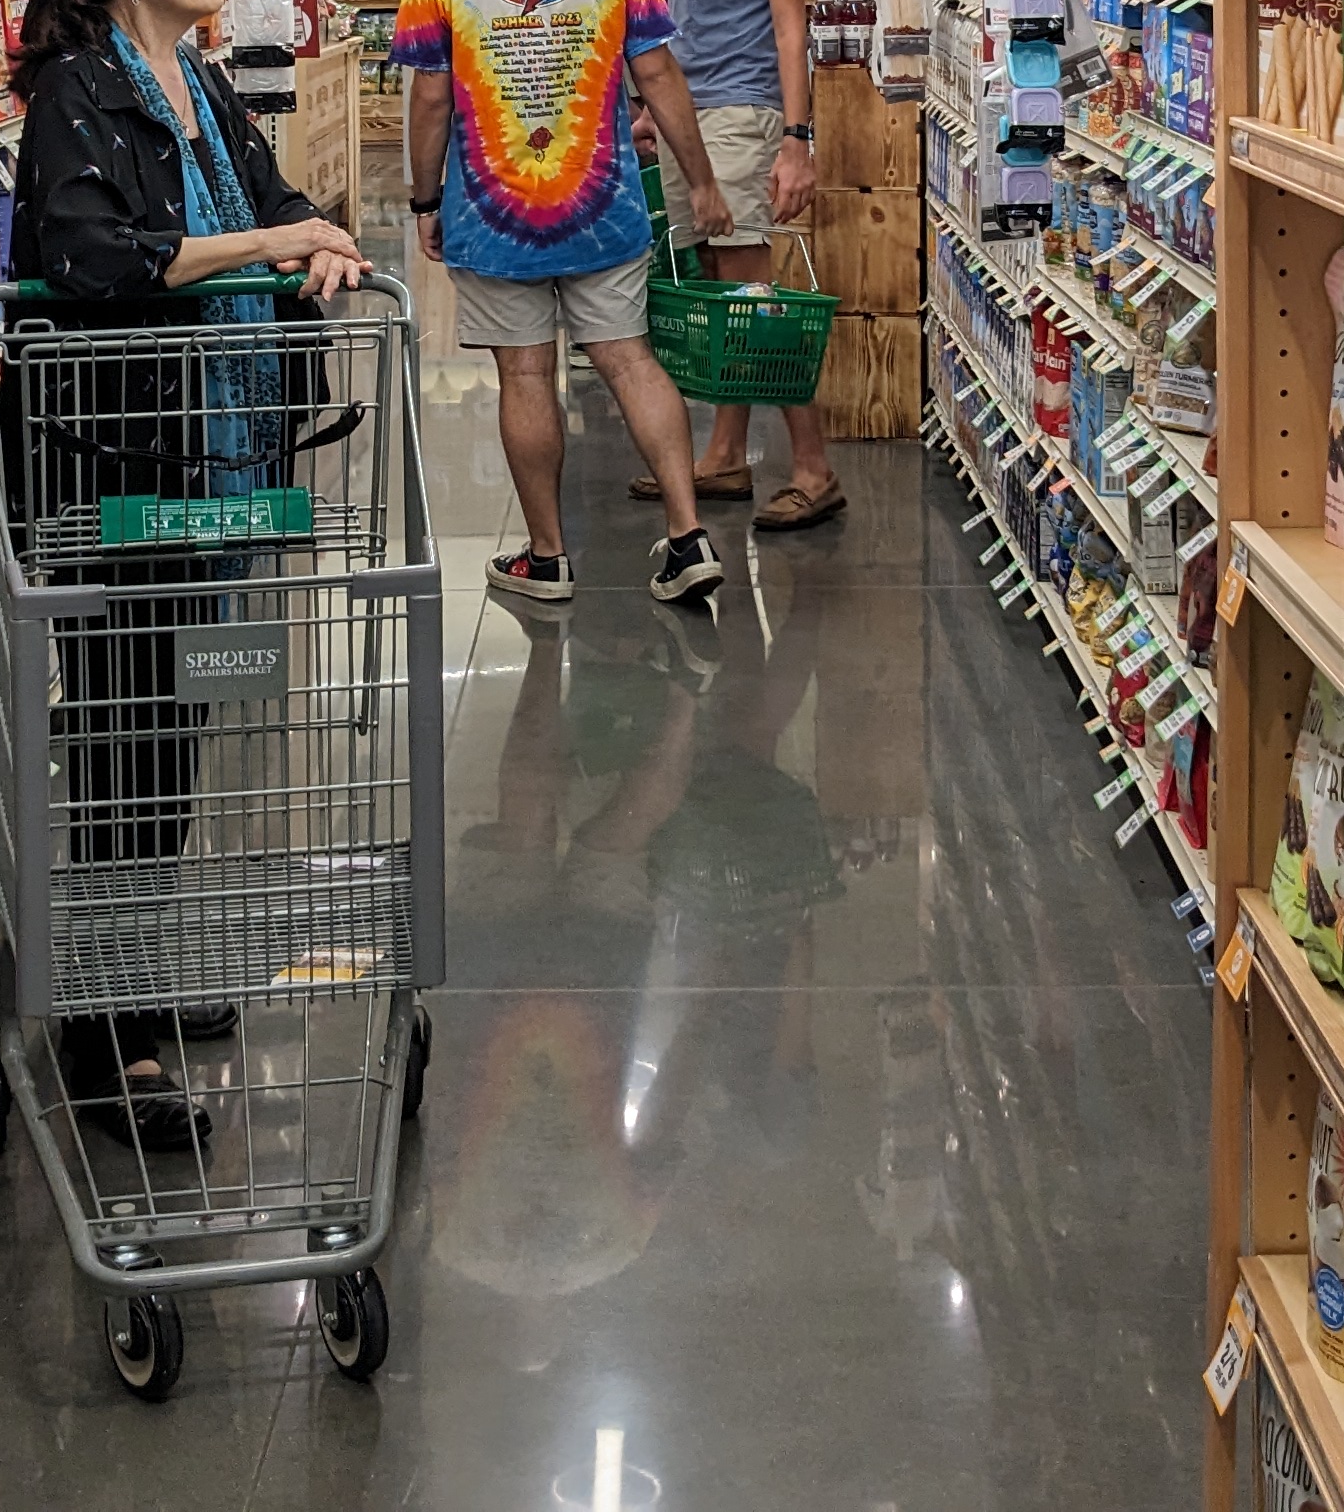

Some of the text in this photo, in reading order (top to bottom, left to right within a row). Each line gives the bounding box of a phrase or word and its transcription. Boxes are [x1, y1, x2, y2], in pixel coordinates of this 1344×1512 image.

[492, 12, 582, 31] SUMMER 2023
[185, 649, 278, 669] SPROUTS
[189, 665, 272, 678] FARMERS MARKET
